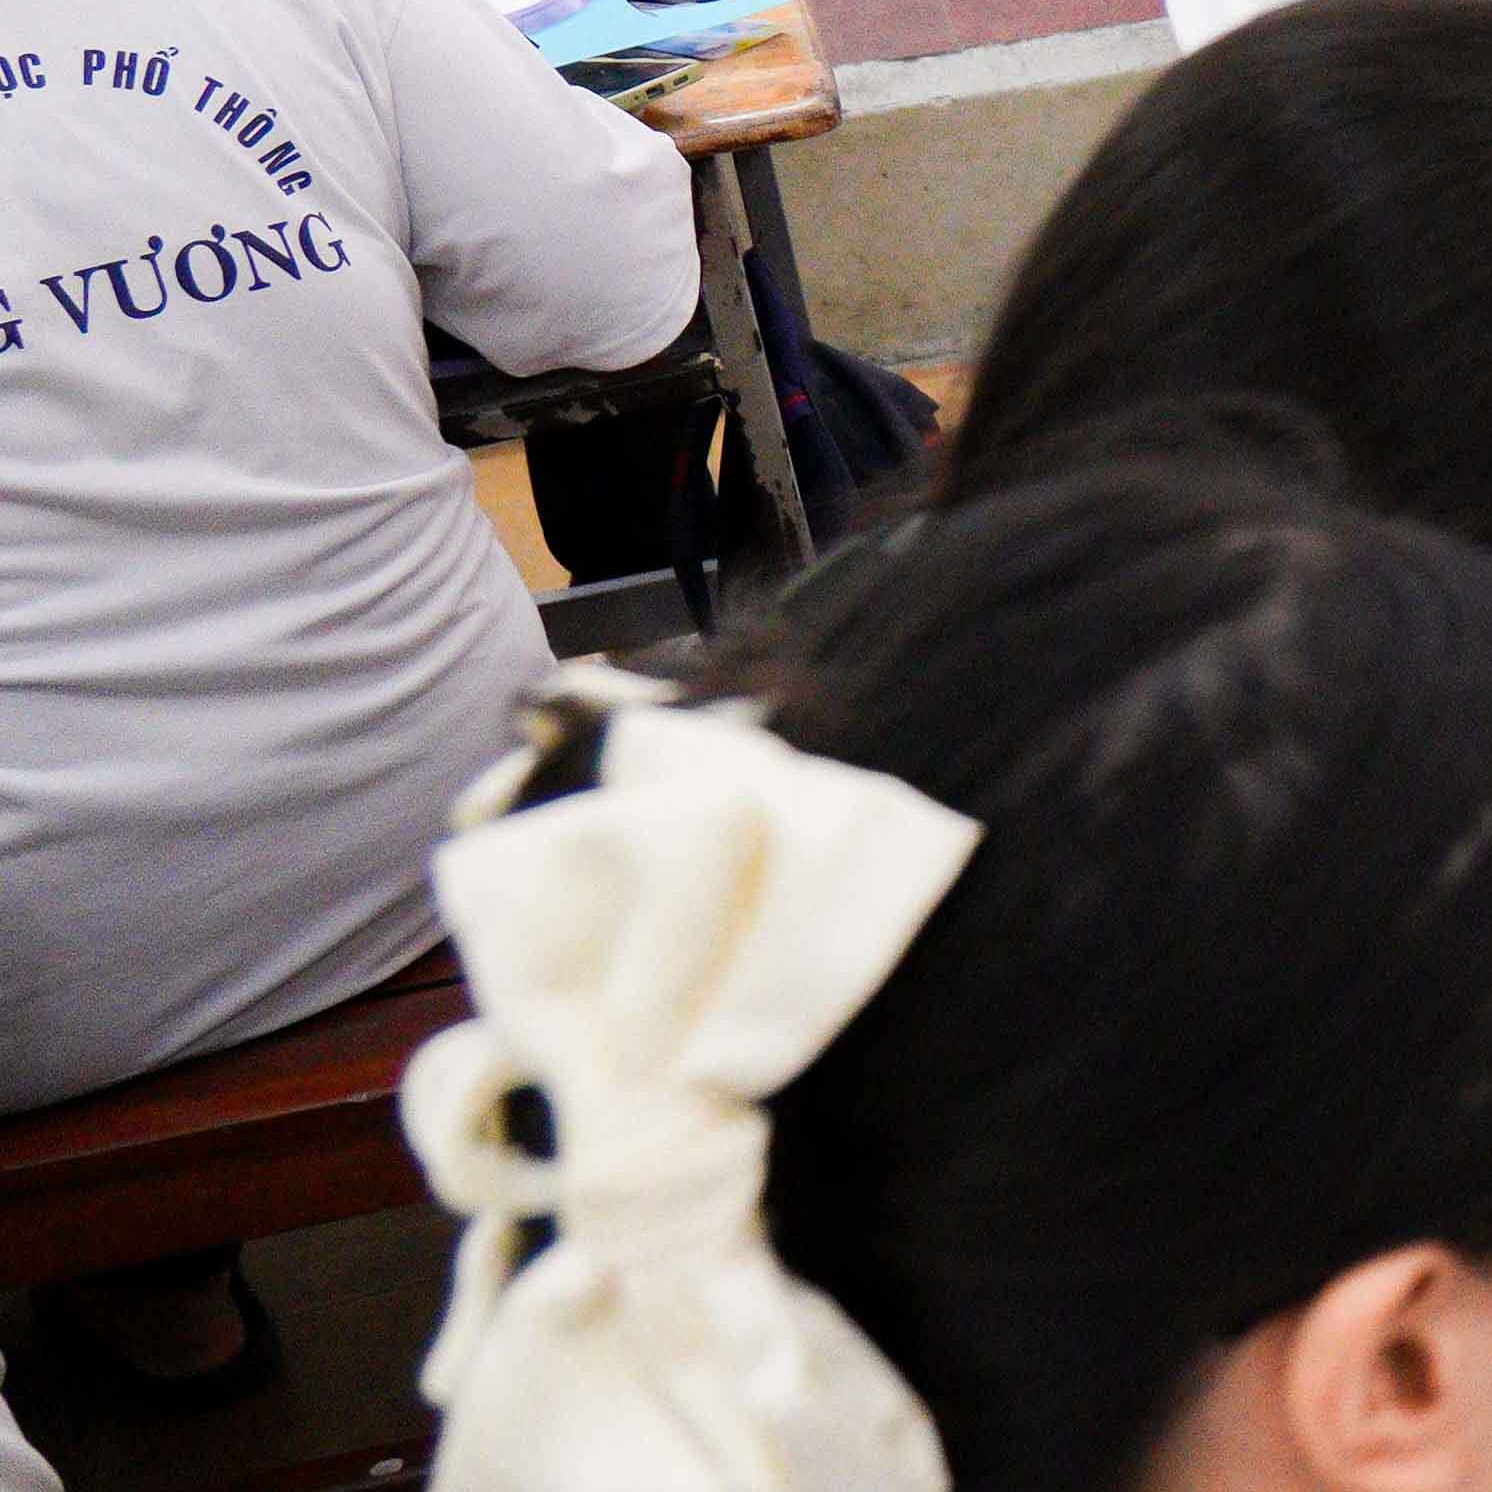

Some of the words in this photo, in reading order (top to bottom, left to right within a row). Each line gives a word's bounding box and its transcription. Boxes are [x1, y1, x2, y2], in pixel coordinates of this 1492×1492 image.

[83, 46, 179, 97] PHỔ
[194, 75, 312, 197] THÔNG
[39, 211, 352, 334] VƯƠNG
